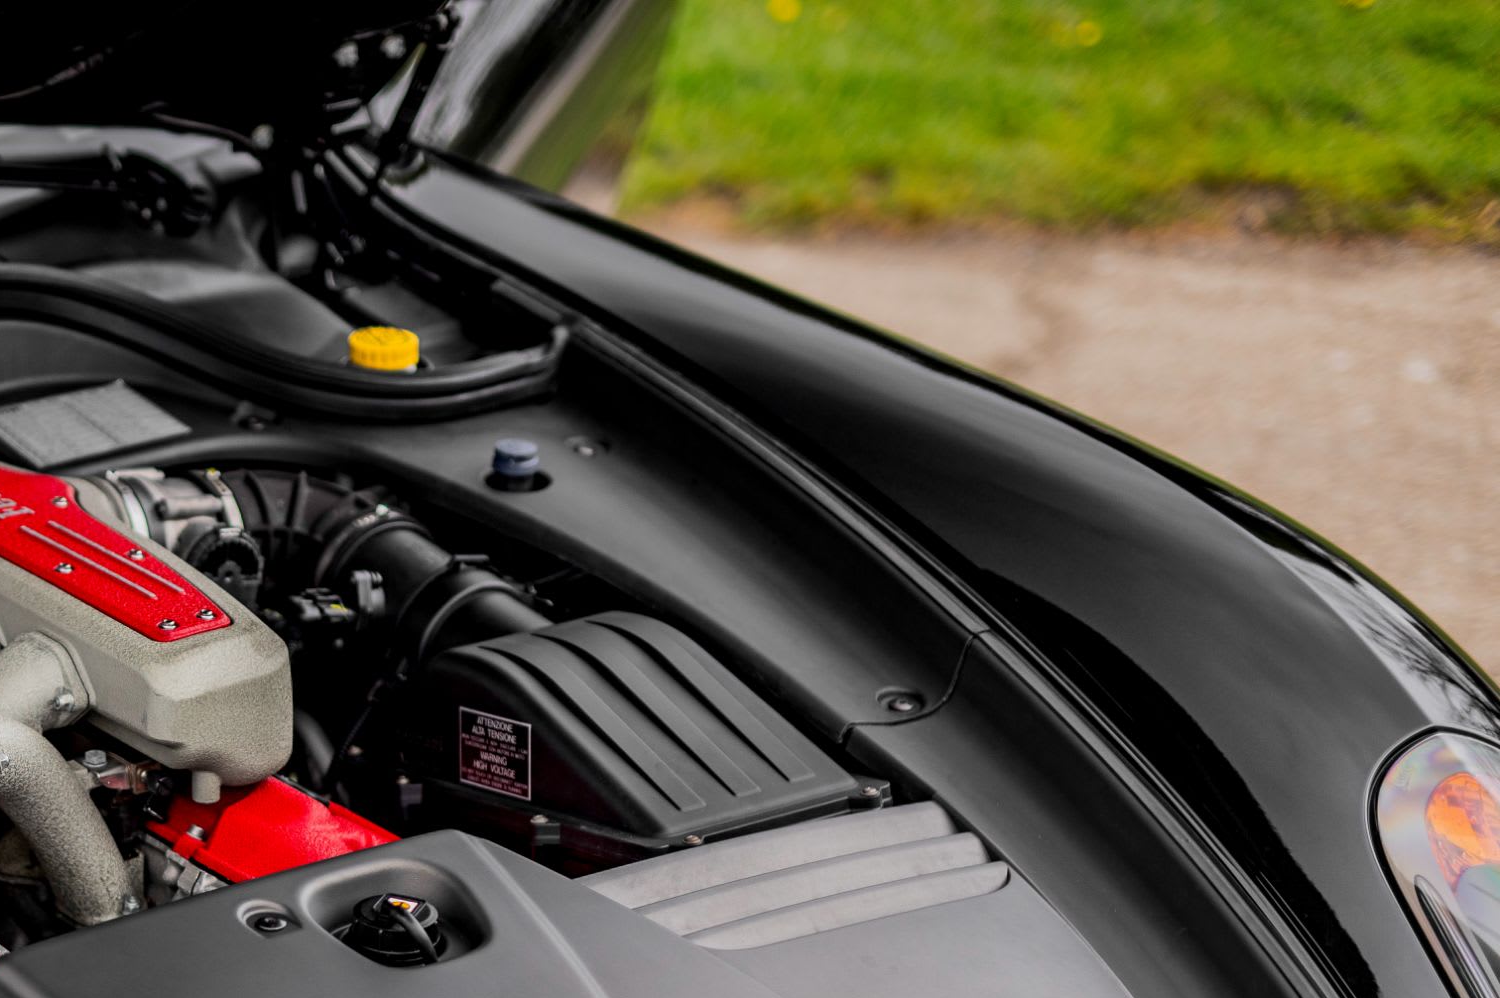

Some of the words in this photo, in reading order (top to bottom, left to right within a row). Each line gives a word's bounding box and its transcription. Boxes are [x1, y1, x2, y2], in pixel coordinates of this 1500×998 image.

[477, 716, 513, 733] ATTENZIONE
[472, 725, 485, 736] ALTA
[487, 728, 516, 744] TENSIONE
[480, 751, 507, 766] WARNING
[473, 760, 487, 770] HIGH
[490, 764, 516, 779] VOLTAGE
